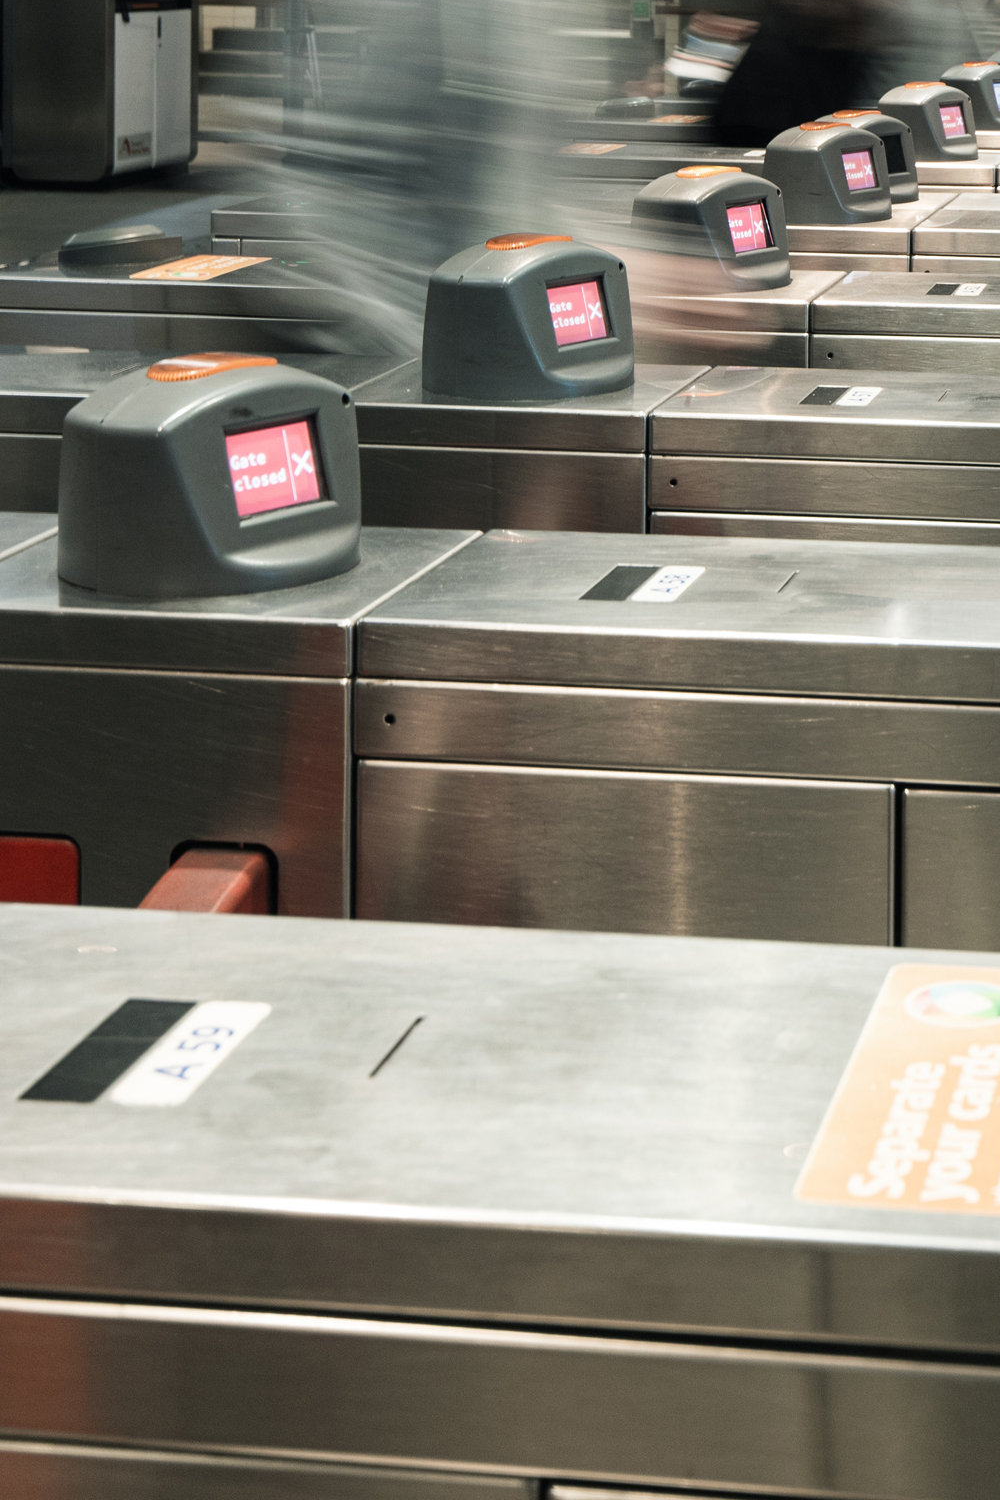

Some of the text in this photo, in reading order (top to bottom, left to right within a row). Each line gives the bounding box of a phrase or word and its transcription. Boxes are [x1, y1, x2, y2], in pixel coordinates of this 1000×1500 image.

[731, 228, 752, 240] losed
[548, 301, 573, 314] Gate
[552, 312, 586, 329] closed
[229, 452, 267, 471] Gate
[233, 466, 288, 493] closed
[846, 1061, 947, 1199] Separate
[919, 1121, 983, 1204] your
